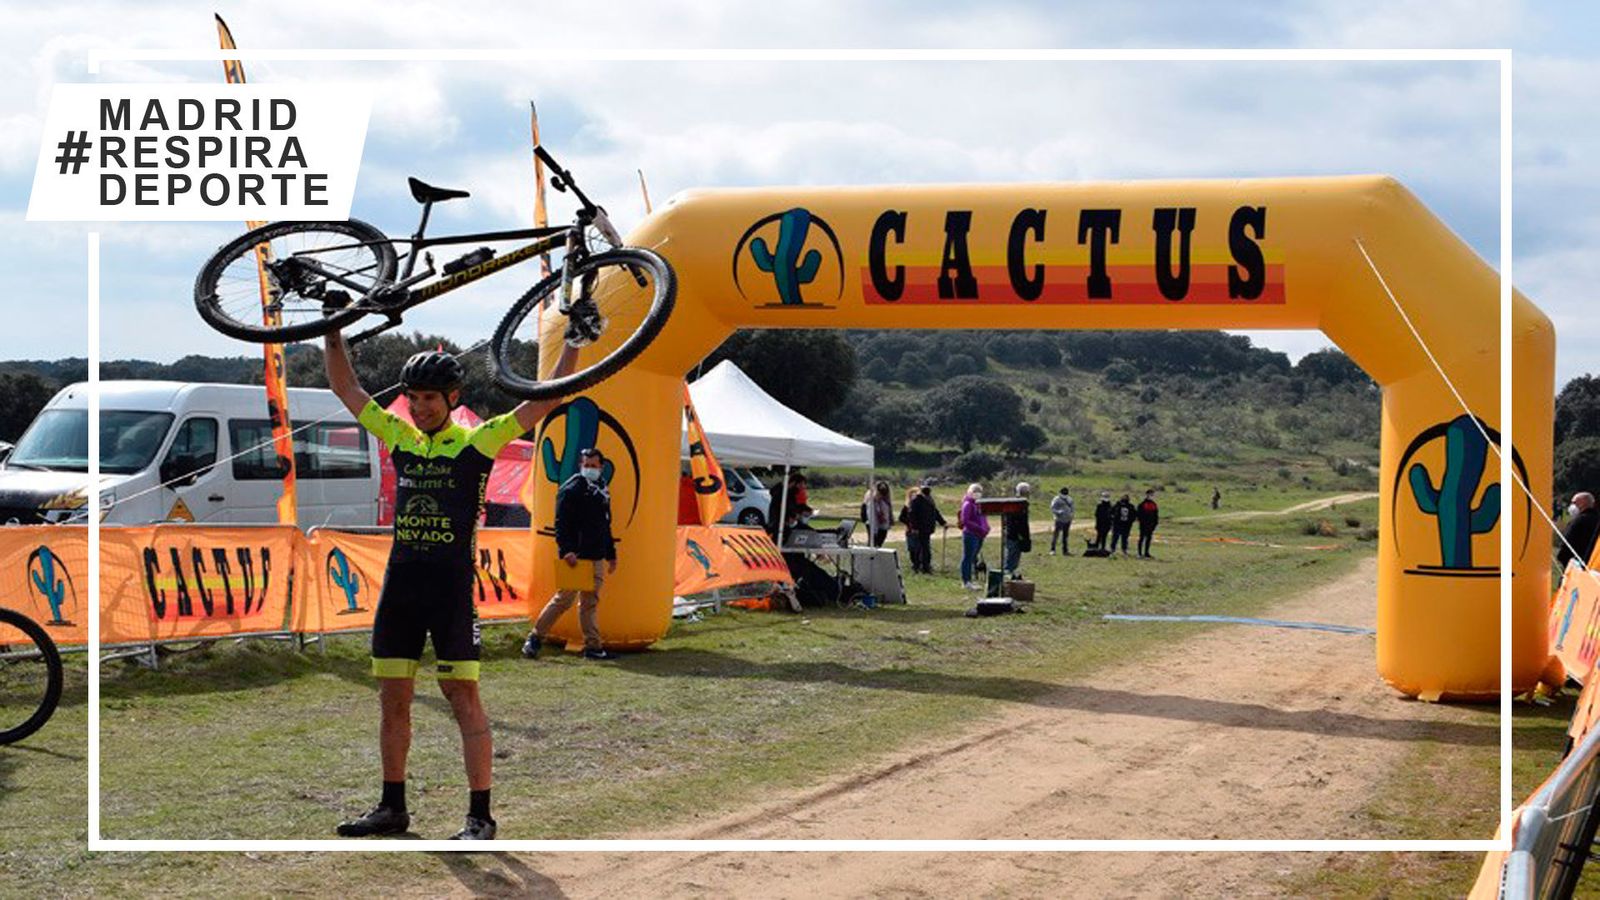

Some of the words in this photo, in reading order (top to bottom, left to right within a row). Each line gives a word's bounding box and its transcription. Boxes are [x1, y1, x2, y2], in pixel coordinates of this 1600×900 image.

[868, 205, 1267, 301] CACTUS
[397, 514, 452, 529] MONTE
[397, 528, 455, 543] NEVADO
[144, 547, 270, 620] CACTUS
